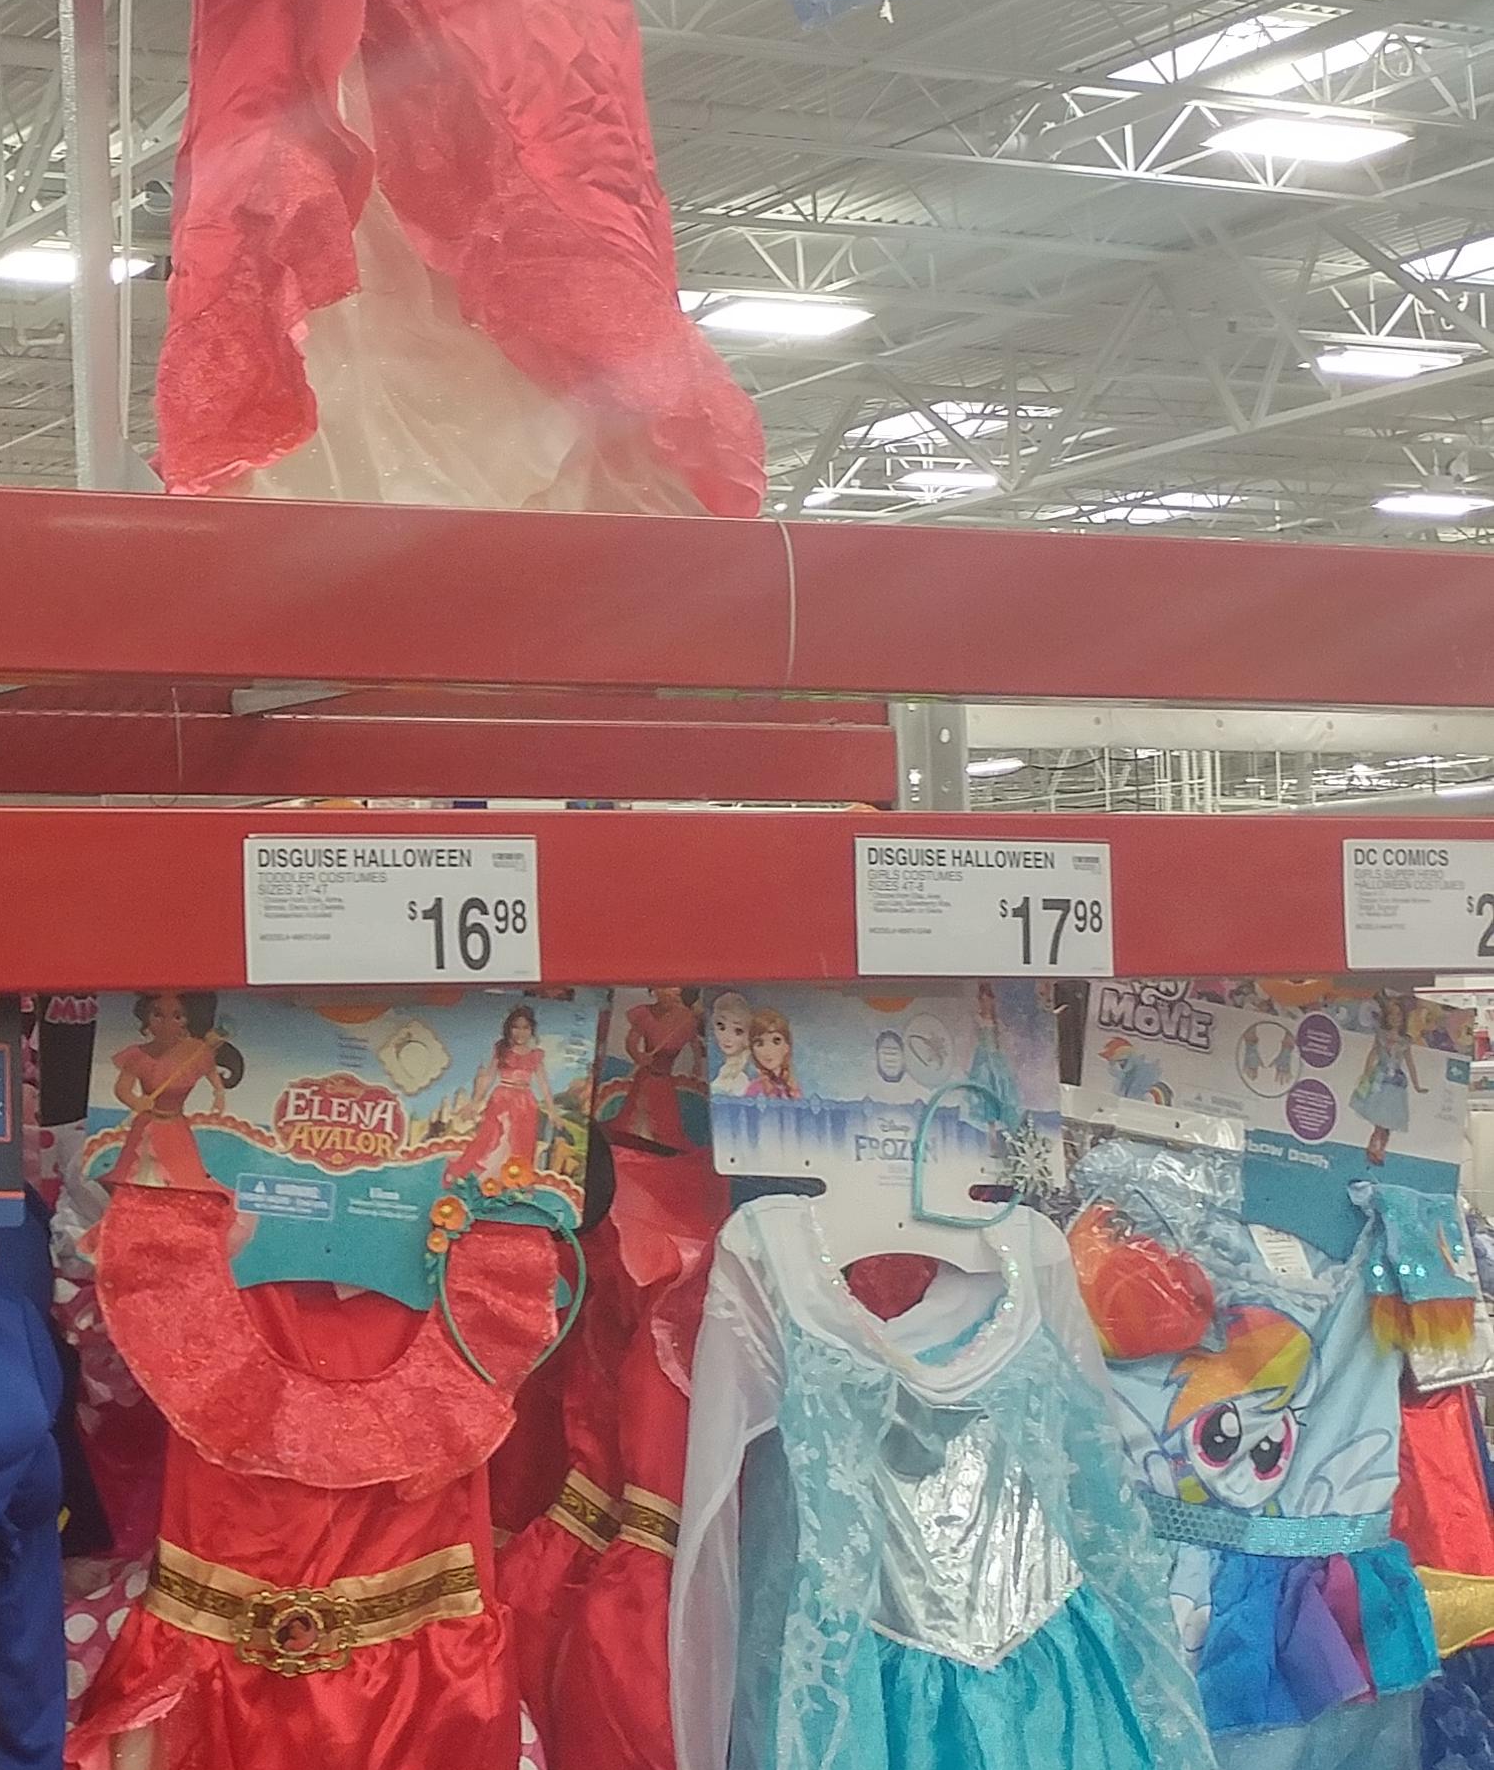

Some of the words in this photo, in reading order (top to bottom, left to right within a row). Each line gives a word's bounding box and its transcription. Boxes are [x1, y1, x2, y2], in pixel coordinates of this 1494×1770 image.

[258, 848, 347, 868] DISGUISE
[354, 848, 472, 868] HALLOWEEN
[867, 847, 946, 867] DISGUISE
[951, 849, 1055, 869] HALLOWEEN
[1354, 848, 1378, 866] DC
[1383, 848, 1450, 867] COMICS
[277, 1086, 399, 1140] ELENA
[280, 1121, 395, 1158] AVALOR
